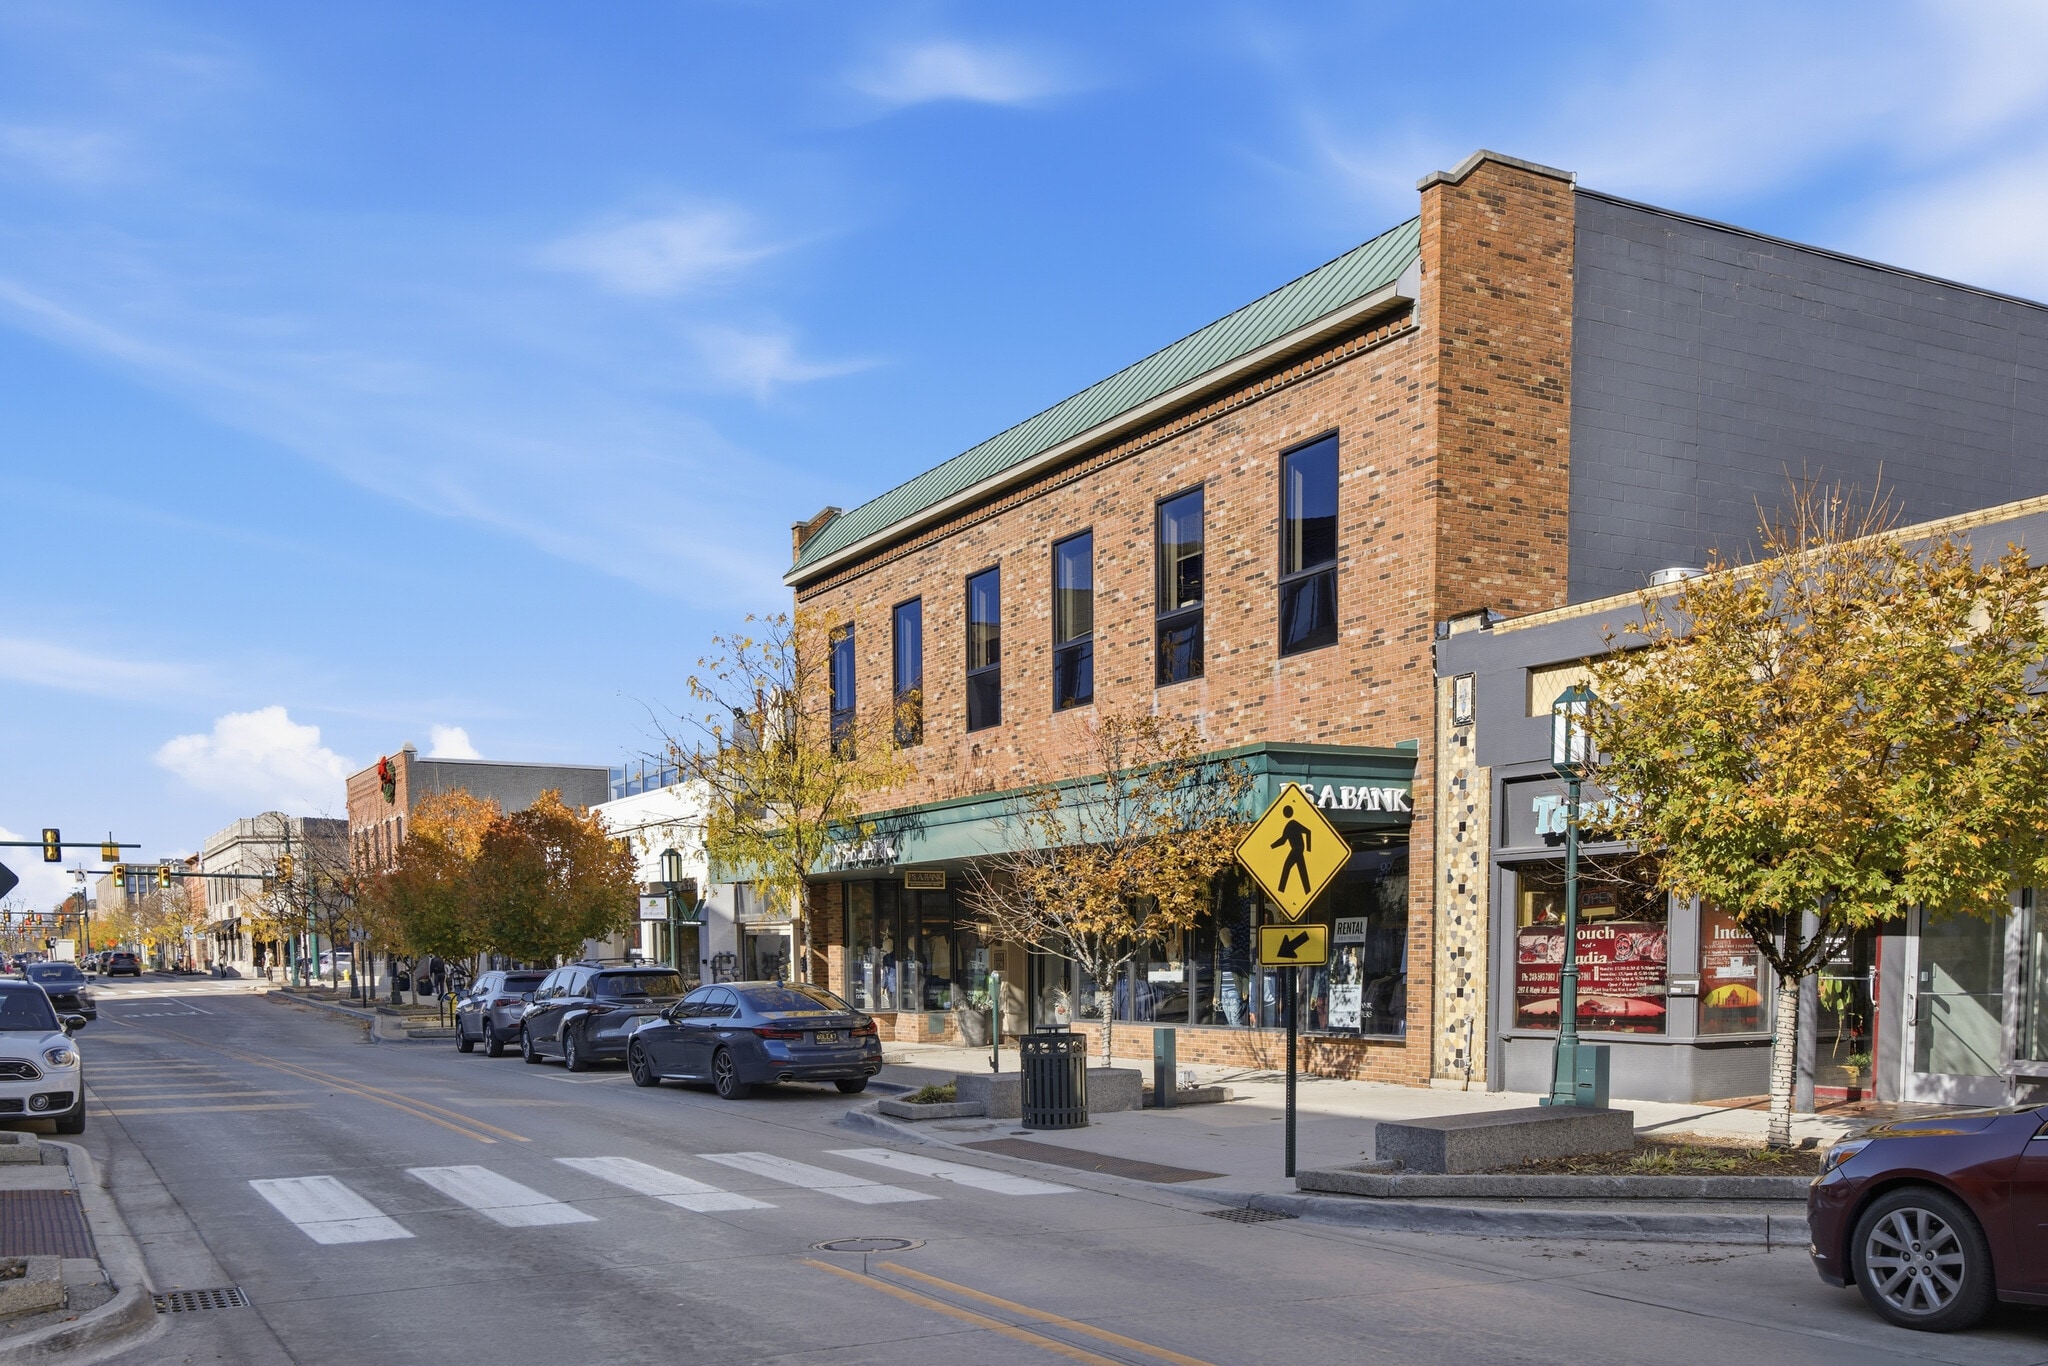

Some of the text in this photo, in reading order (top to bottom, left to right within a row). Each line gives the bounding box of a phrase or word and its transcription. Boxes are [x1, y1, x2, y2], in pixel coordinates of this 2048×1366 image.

[1337, 921, 1364, 935] RENTAL
[1576, 926, 1615, 939] ouch
[1576, 952, 1607, 964] ndia
